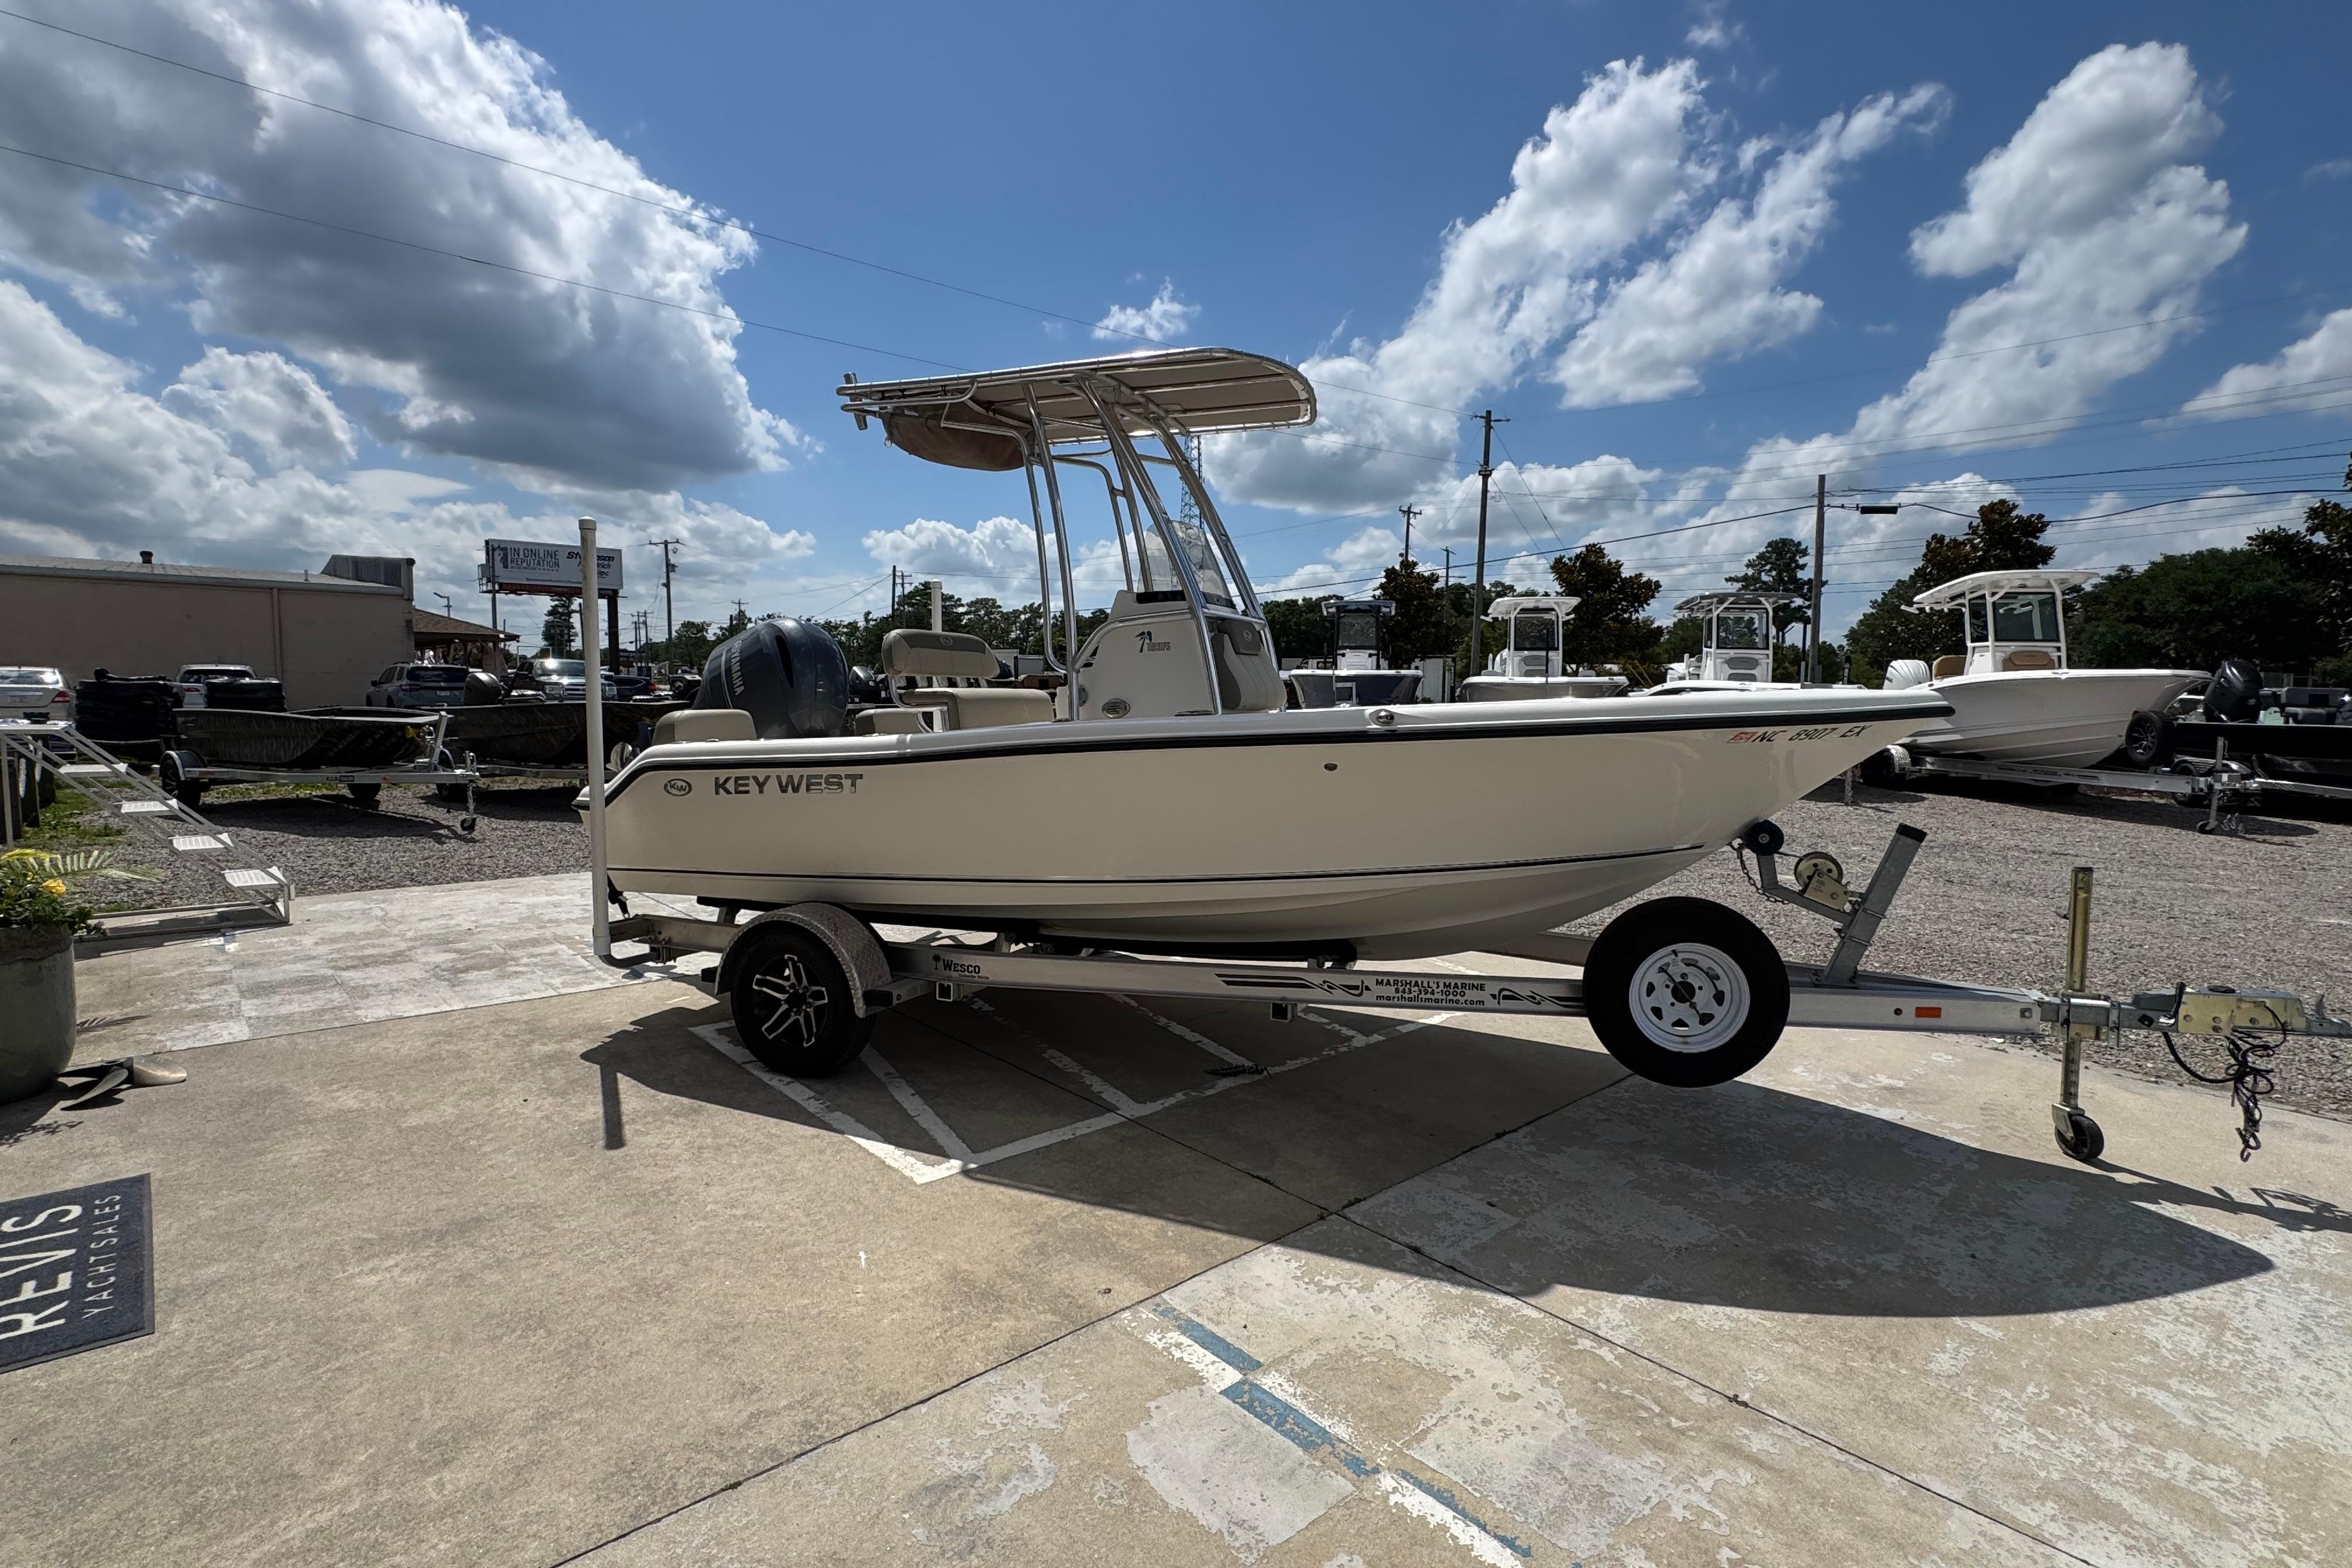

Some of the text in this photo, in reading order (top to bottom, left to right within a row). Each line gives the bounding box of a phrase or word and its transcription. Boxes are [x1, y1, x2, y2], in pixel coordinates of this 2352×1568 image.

[510, 547, 520, 557] IN
[523, 548, 559, 560] ONLINE
[510, 558, 560, 569] REPUTATION
[730, 650, 745, 696] YAMAHA
[1751, 730, 1787, 743] NC
[1788, 727, 1839, 741] 8907
[714, 774, 863, 796] KEY WEST
[1376, 978, 1486, 992] MARSHALL'S MARINE
[1394, 987, 1466, 998] 843-394-1000
[1376, 994, 1485, 1006] marshallsmarine.com
[82, 1194, 121, 1320] YACHT SALES
[0, 1205, 83, 1340] REVIS
